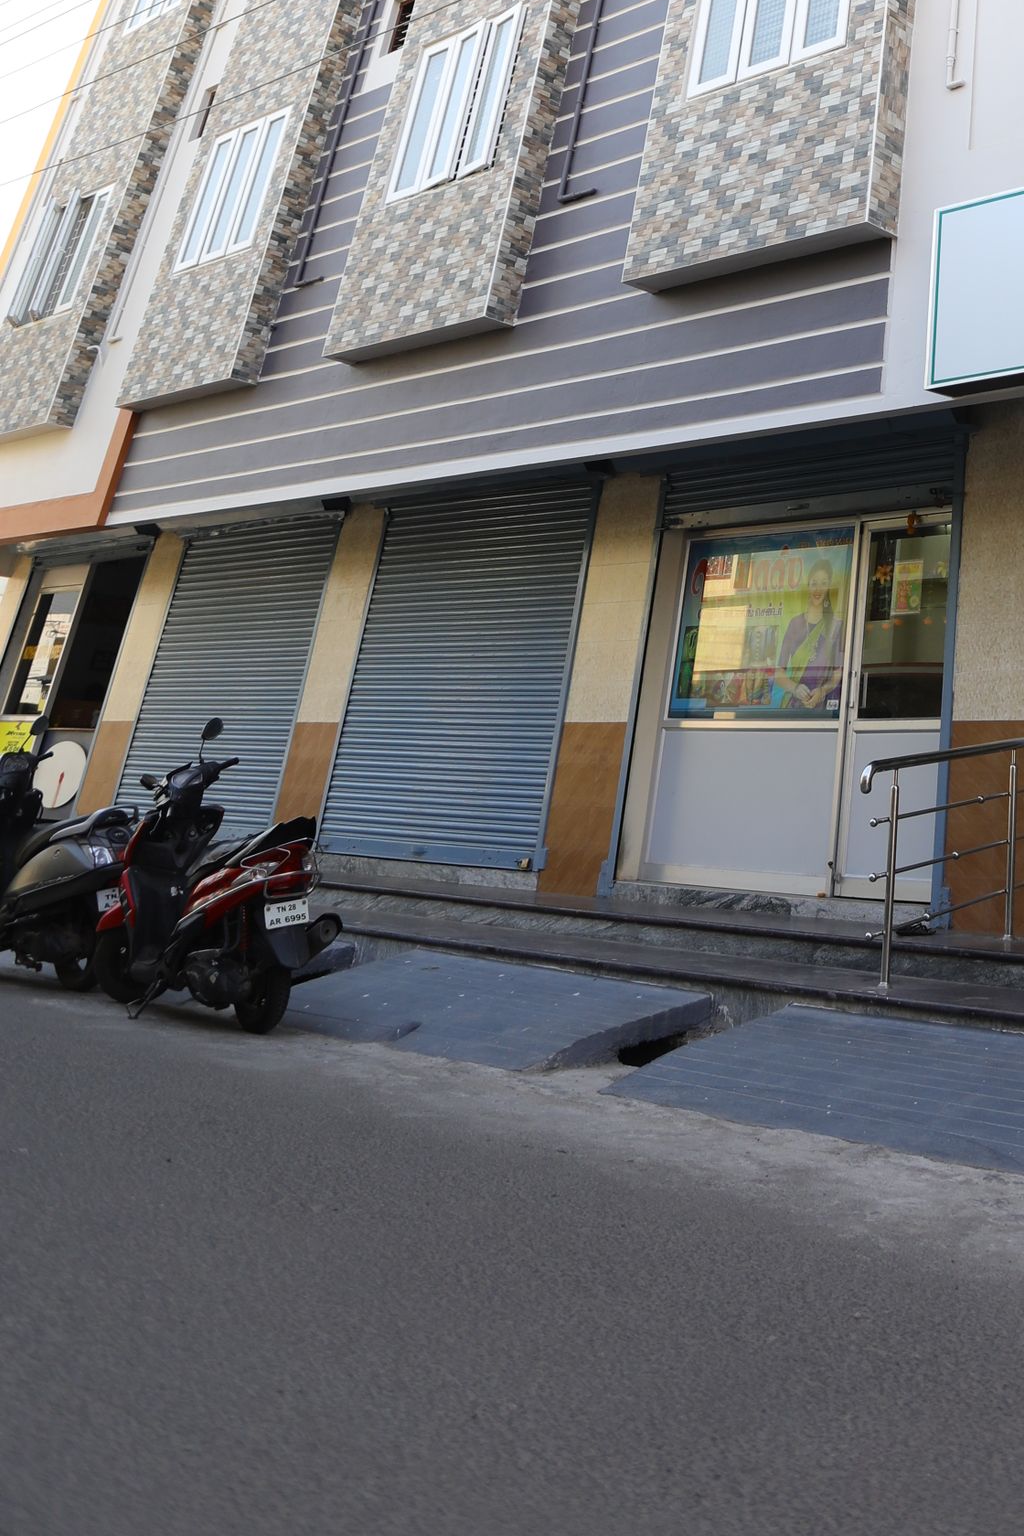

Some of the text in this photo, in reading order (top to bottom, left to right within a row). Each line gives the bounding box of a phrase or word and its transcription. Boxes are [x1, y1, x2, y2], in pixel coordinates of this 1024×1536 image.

[276, 903, 297, 913] TN 28
[270, 913, 307, 926] AR 6995
